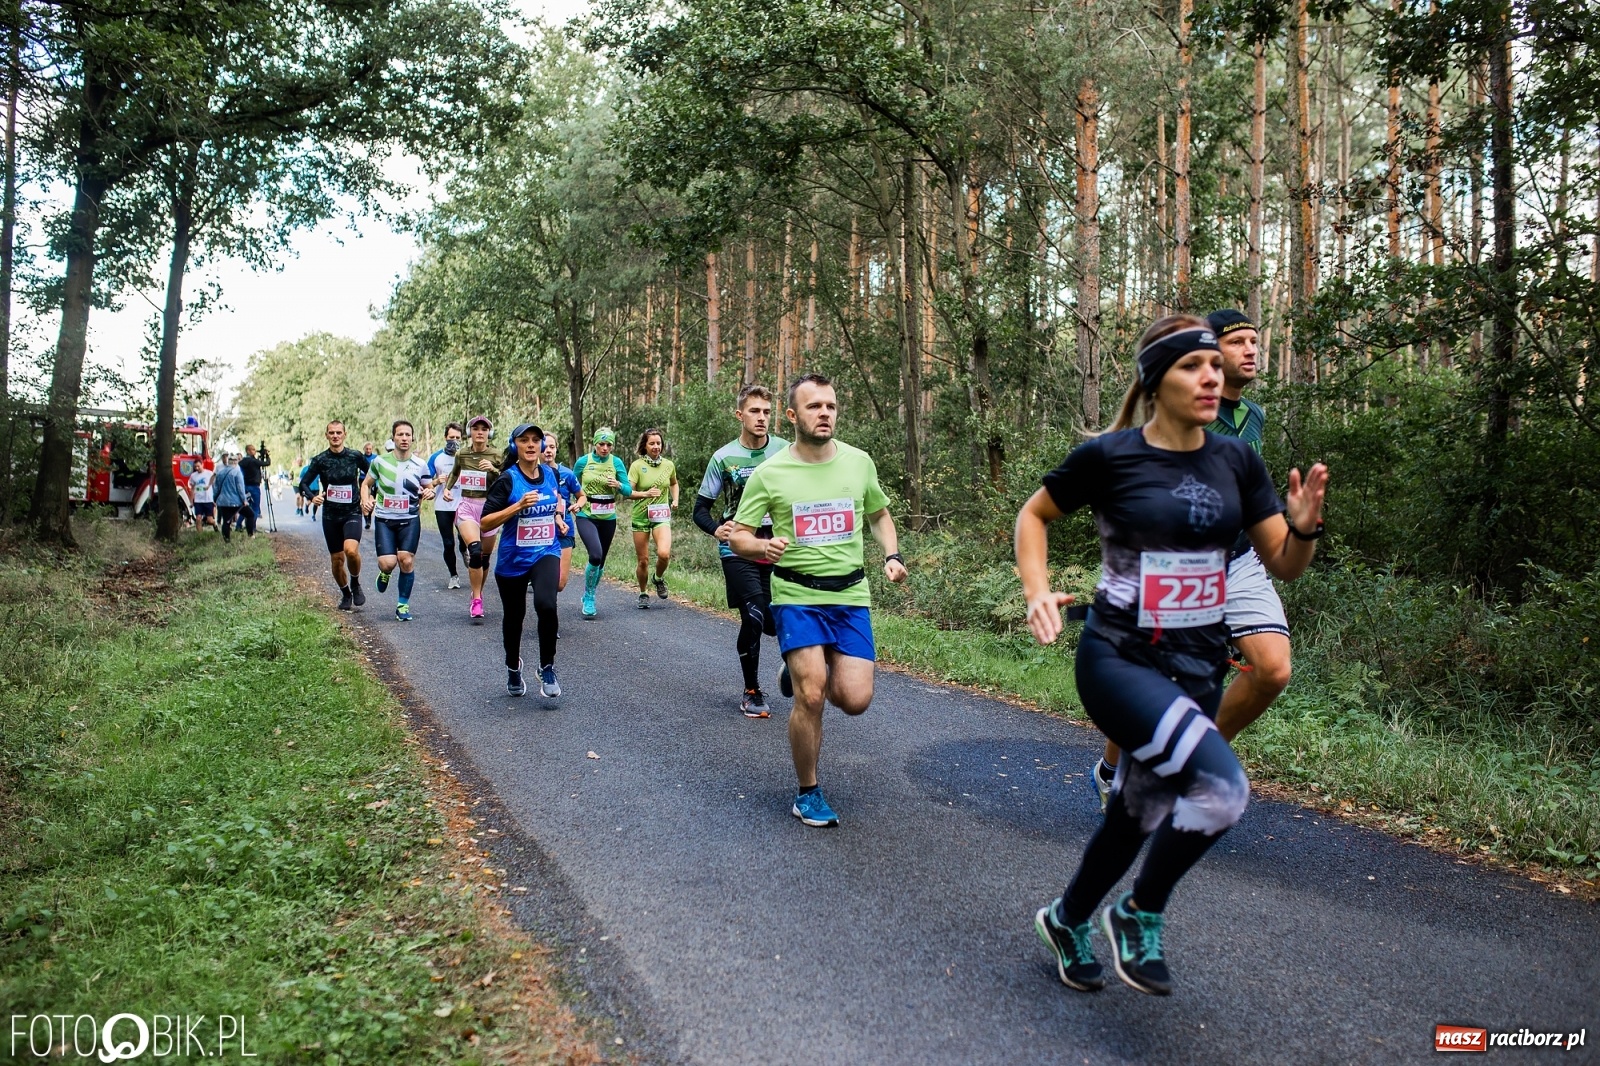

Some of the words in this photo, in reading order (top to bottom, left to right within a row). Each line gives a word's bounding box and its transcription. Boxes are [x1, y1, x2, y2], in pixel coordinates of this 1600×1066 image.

[465, 477, 480, 486] 216
[332, 490, 347, 498] 230
[388, 501, 404, 509] 221
[652, 510, 667, 518] 220
[803, 513, 846, 535] 208
[524, 526, 550, 540] 228
[1158, 575, 1219, 609] 225
